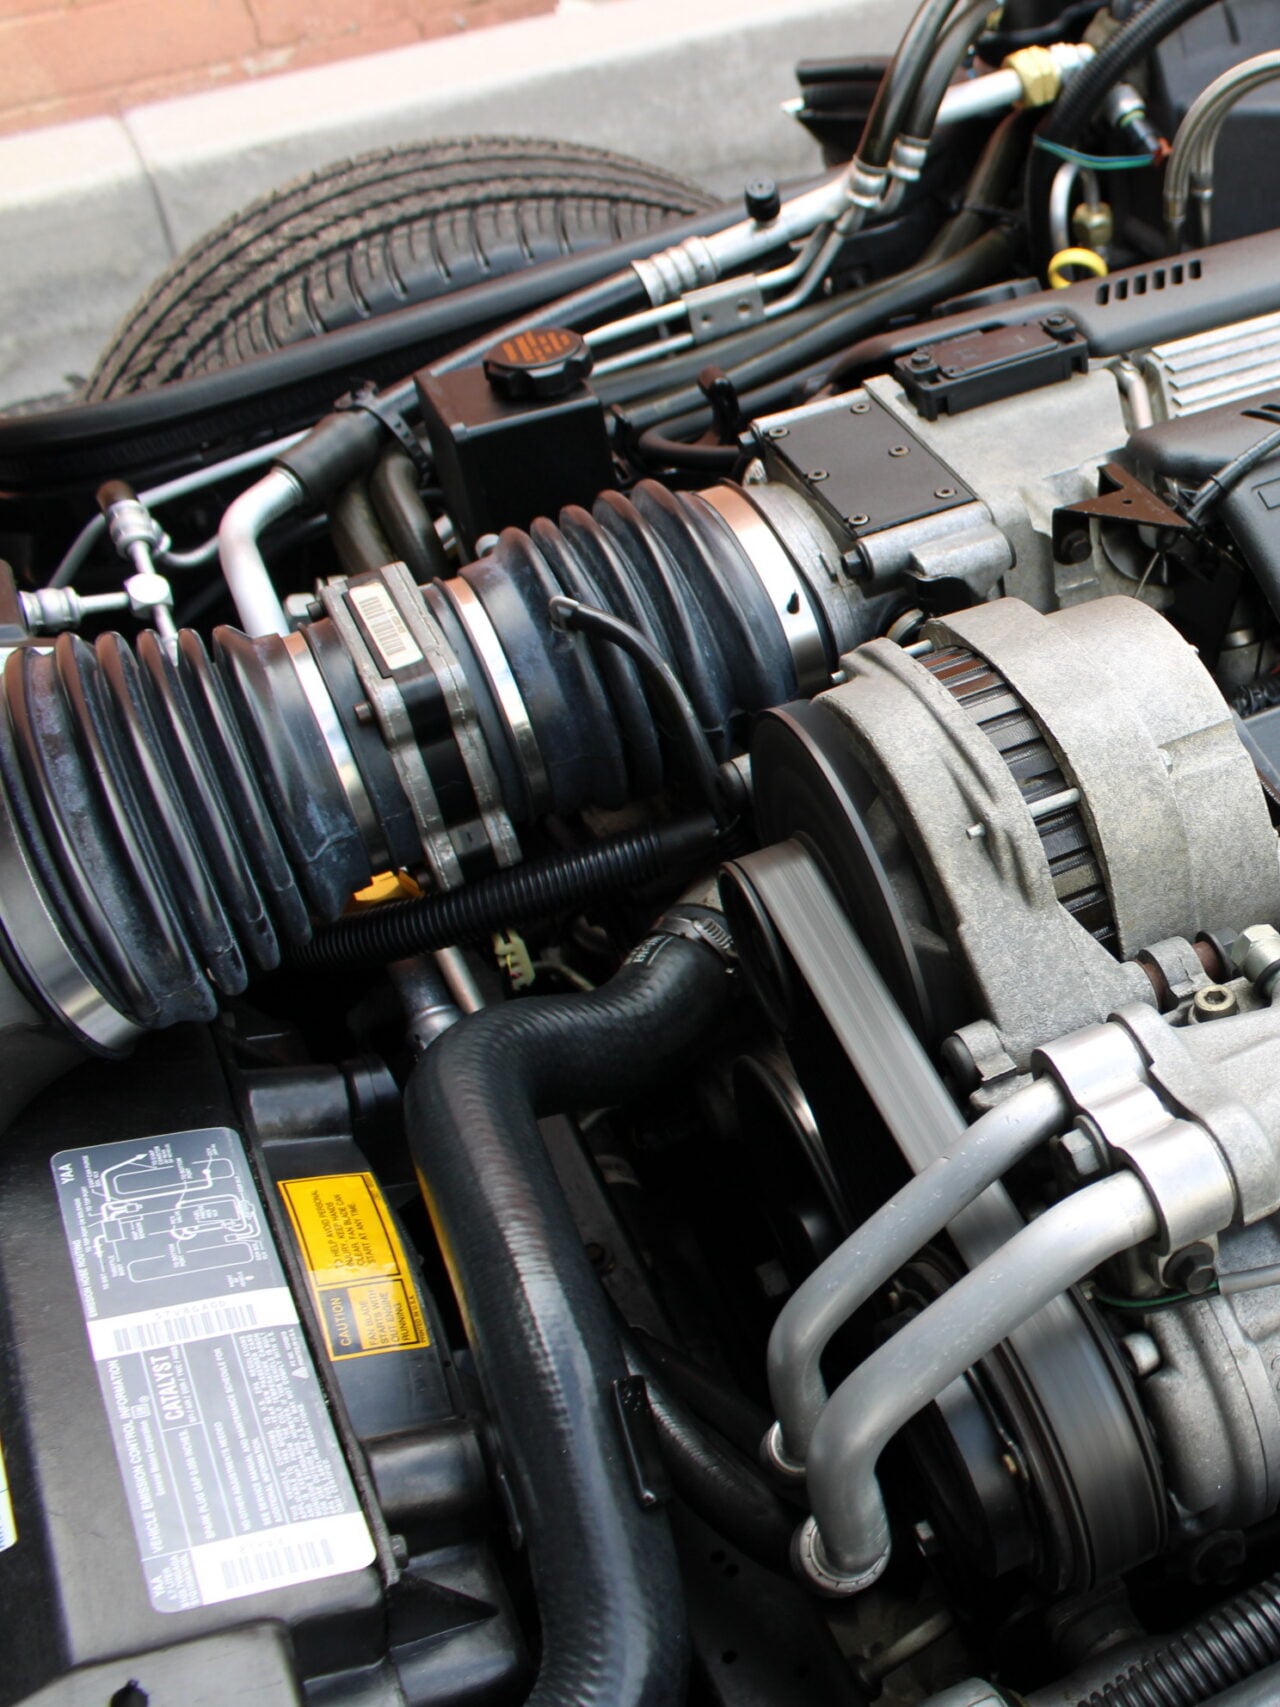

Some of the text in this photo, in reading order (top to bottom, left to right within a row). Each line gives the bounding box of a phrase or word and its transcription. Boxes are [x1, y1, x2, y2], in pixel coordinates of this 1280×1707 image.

[58, 1163, 74, 1183] YAA
[310, 1190, 326, 1217] PERSONAL
[333, 1194, 343, 1205] CAN
[326, 1202, 338, 1220] HANDS
[338, 1207, 351, 1225] BLADE
[320, 1218, 332, 1237] AVOID
[333, 1222, 345, 1238] KEEP
[346, 1227, 356, 1239] FAN
[353, 1218, 363, 1230] ANY
[358, 1232, 367, 1240] AT
[327, 1239, 339, 1257] HELP
[361, 1242, 375, 1263] START
[329, 1297, 352, 1346] CAUTION
[359, 1300, 377, 1345] FAN BLADE
[368, 1290, 388, 1343] STARTS WITH
[379, 1292, 399, 1341] OUT ENGINE
[394, 1302, 410, 1340] RUNNING
[150, 1354, 184, 1420] CATALYST
[107, 1359, 163, 1552] VEHICLE EMISSION CONTROL INFORMATION
[150, 1575, 164, 1597] YAA
